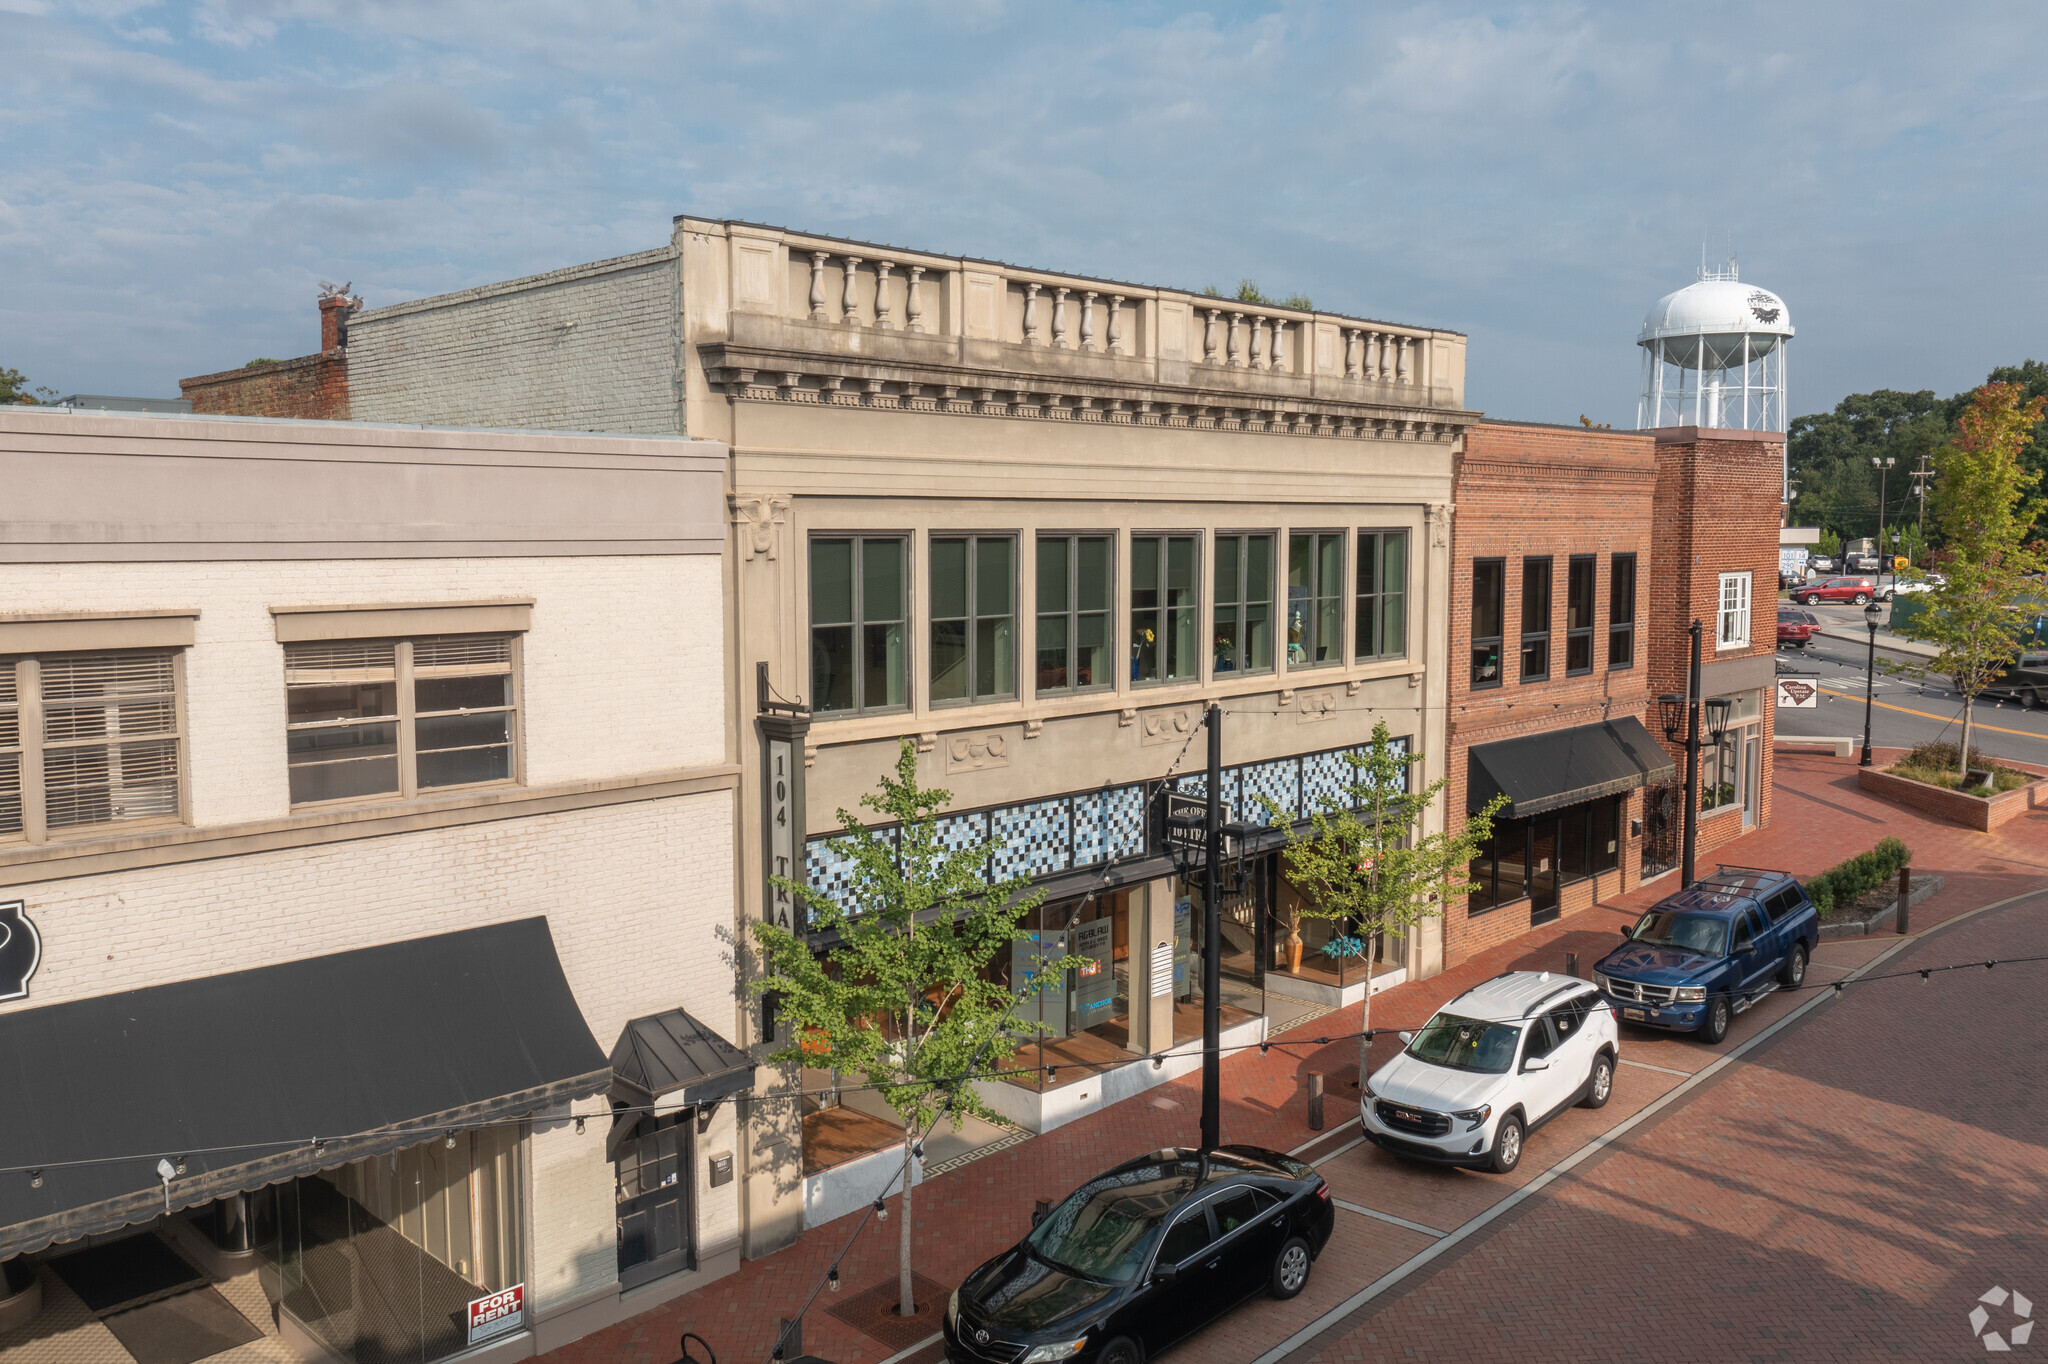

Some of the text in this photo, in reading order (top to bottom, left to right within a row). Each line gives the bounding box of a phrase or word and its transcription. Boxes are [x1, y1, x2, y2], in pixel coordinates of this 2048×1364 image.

[776, 755, 786, 827] 104
[1395, 1110, 1421, 1123] GMC
[473, 1299, 521, 1327] RENT
[479, 1291, 515, 1313] FOR
